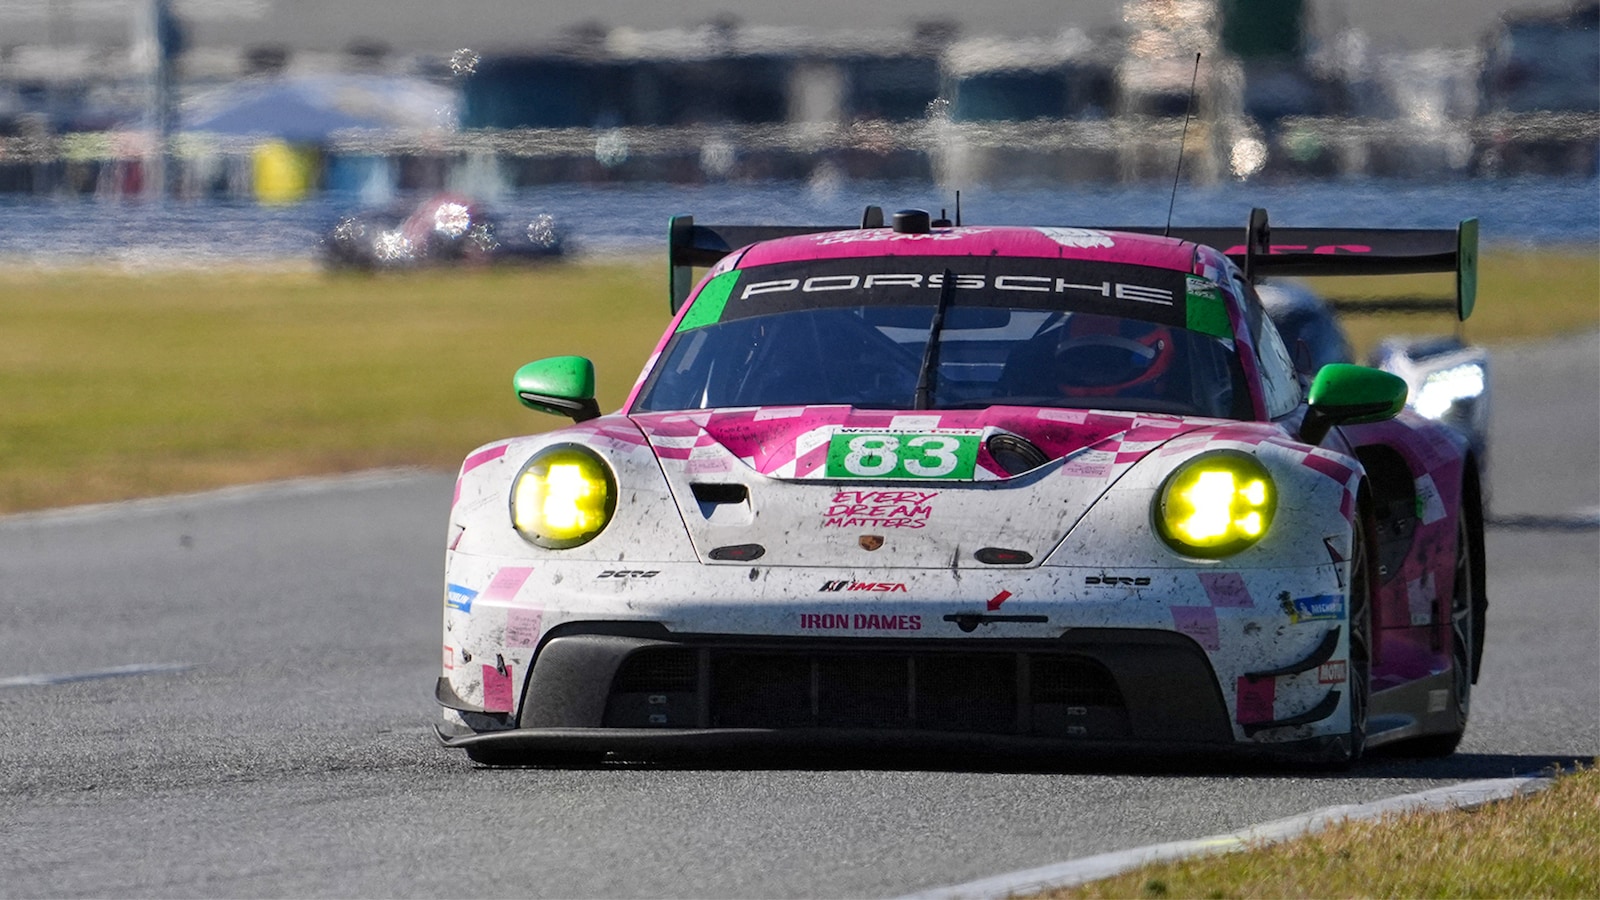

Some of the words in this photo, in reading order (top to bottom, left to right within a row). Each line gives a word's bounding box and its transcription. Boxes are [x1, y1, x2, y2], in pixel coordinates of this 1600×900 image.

[740, 273, 1174, 306] PORSCHE
[844, 435, 960, 477] 83
[832, 490, 938, 506] EVERY
[823, 504, 933, 519] DREAM
[824, 517, 927, 529] MATTERS
[847, 582, 908, 593] IMSA
[800, 613, 849, 629] IRON
[854, 614, 922, 630] DAMES
